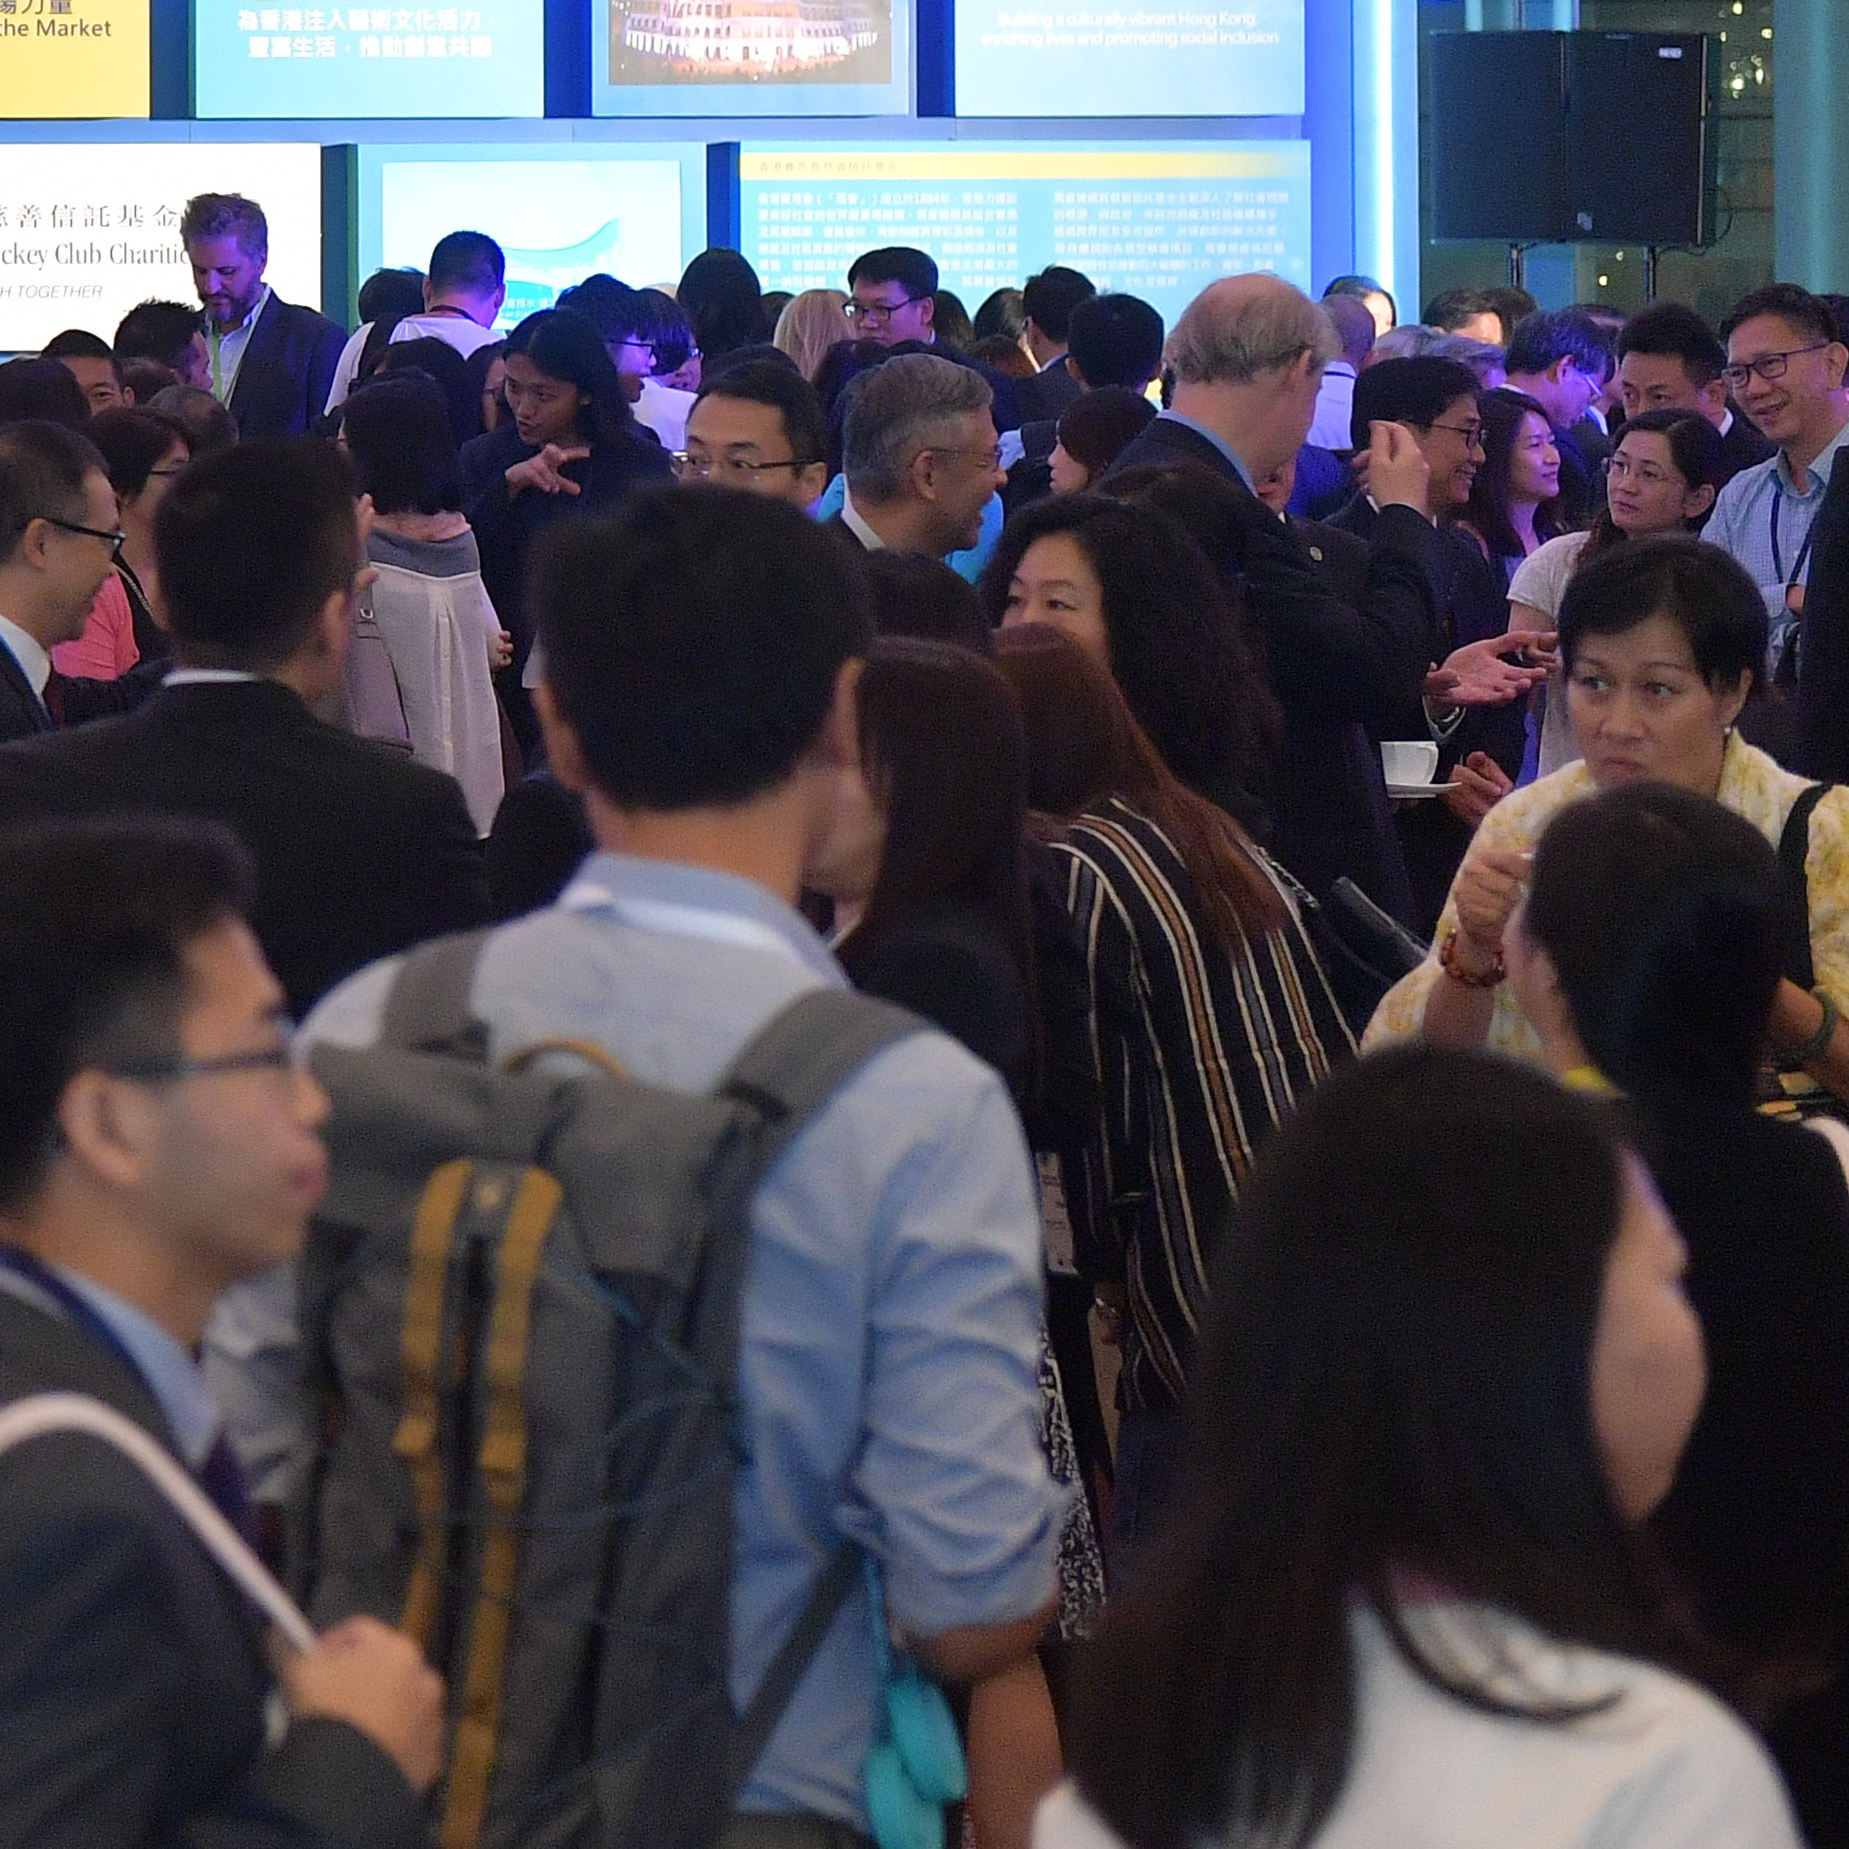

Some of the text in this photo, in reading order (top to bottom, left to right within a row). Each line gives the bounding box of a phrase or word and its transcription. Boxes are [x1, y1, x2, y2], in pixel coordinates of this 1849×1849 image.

[36, 19, 111, 37] Market
[55, 243, 102, 265] Club
[17, 285, 103, 298] TOGETHER
